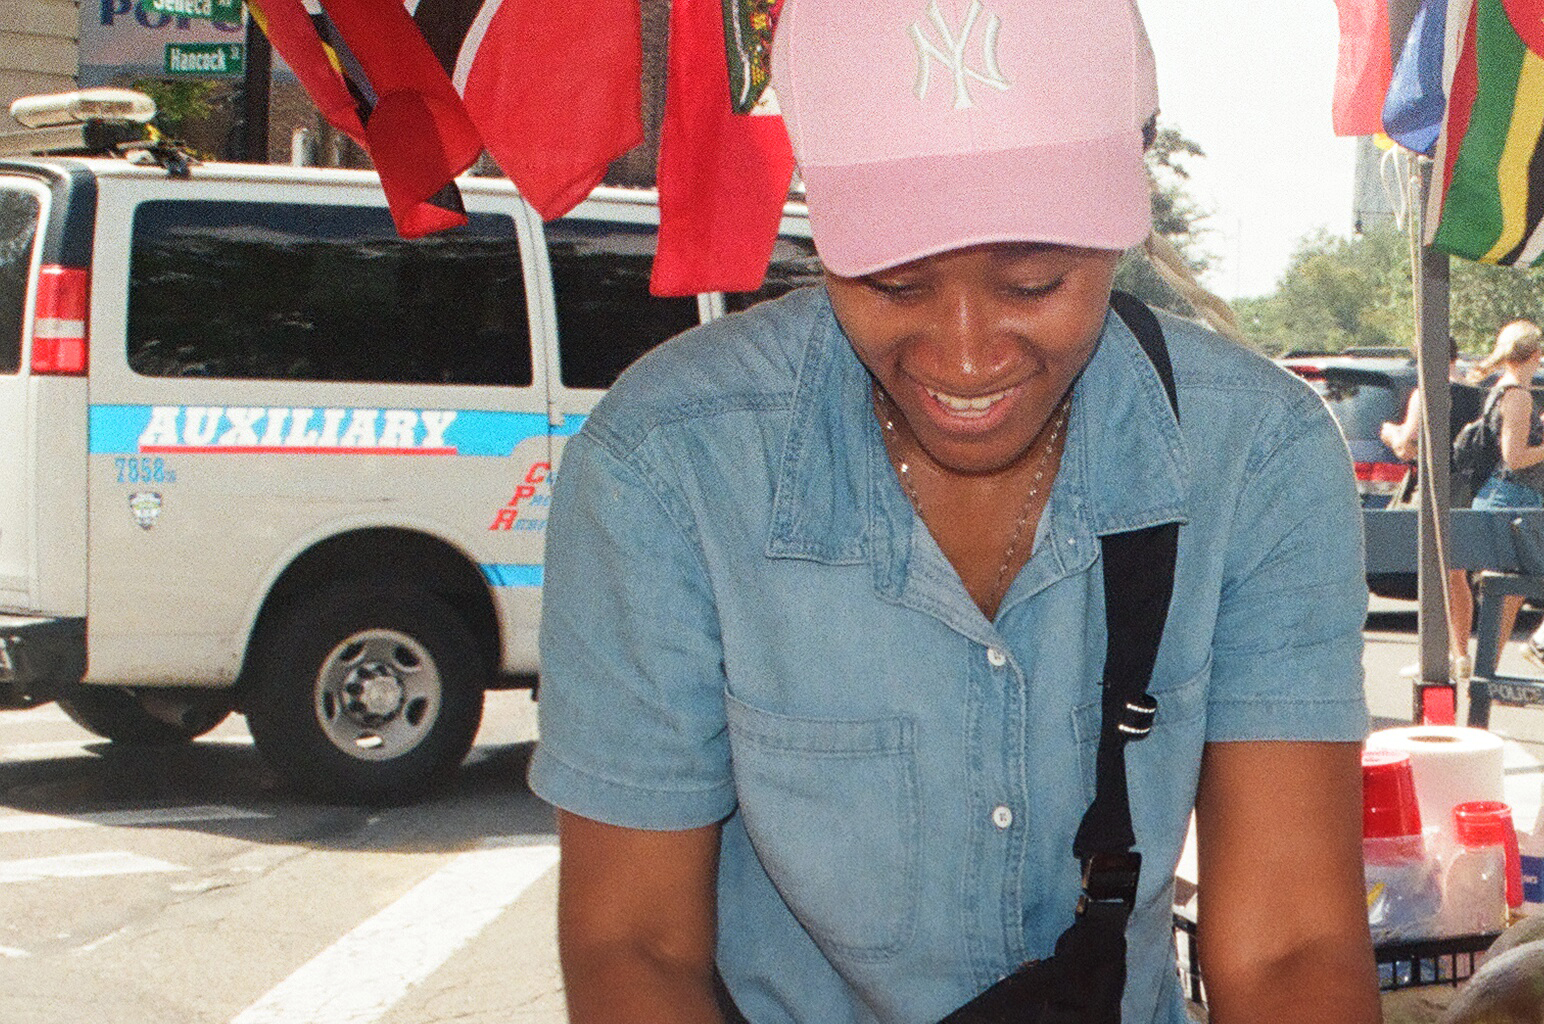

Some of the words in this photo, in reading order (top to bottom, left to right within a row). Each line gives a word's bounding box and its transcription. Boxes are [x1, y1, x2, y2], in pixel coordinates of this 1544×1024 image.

[170, 48, 227, 71] Hancock
[139, 405, 458, 447] AUXILIARY
[114, 457, 165, 484] 7858
[1487, 683, 1544, 703] POLICE
